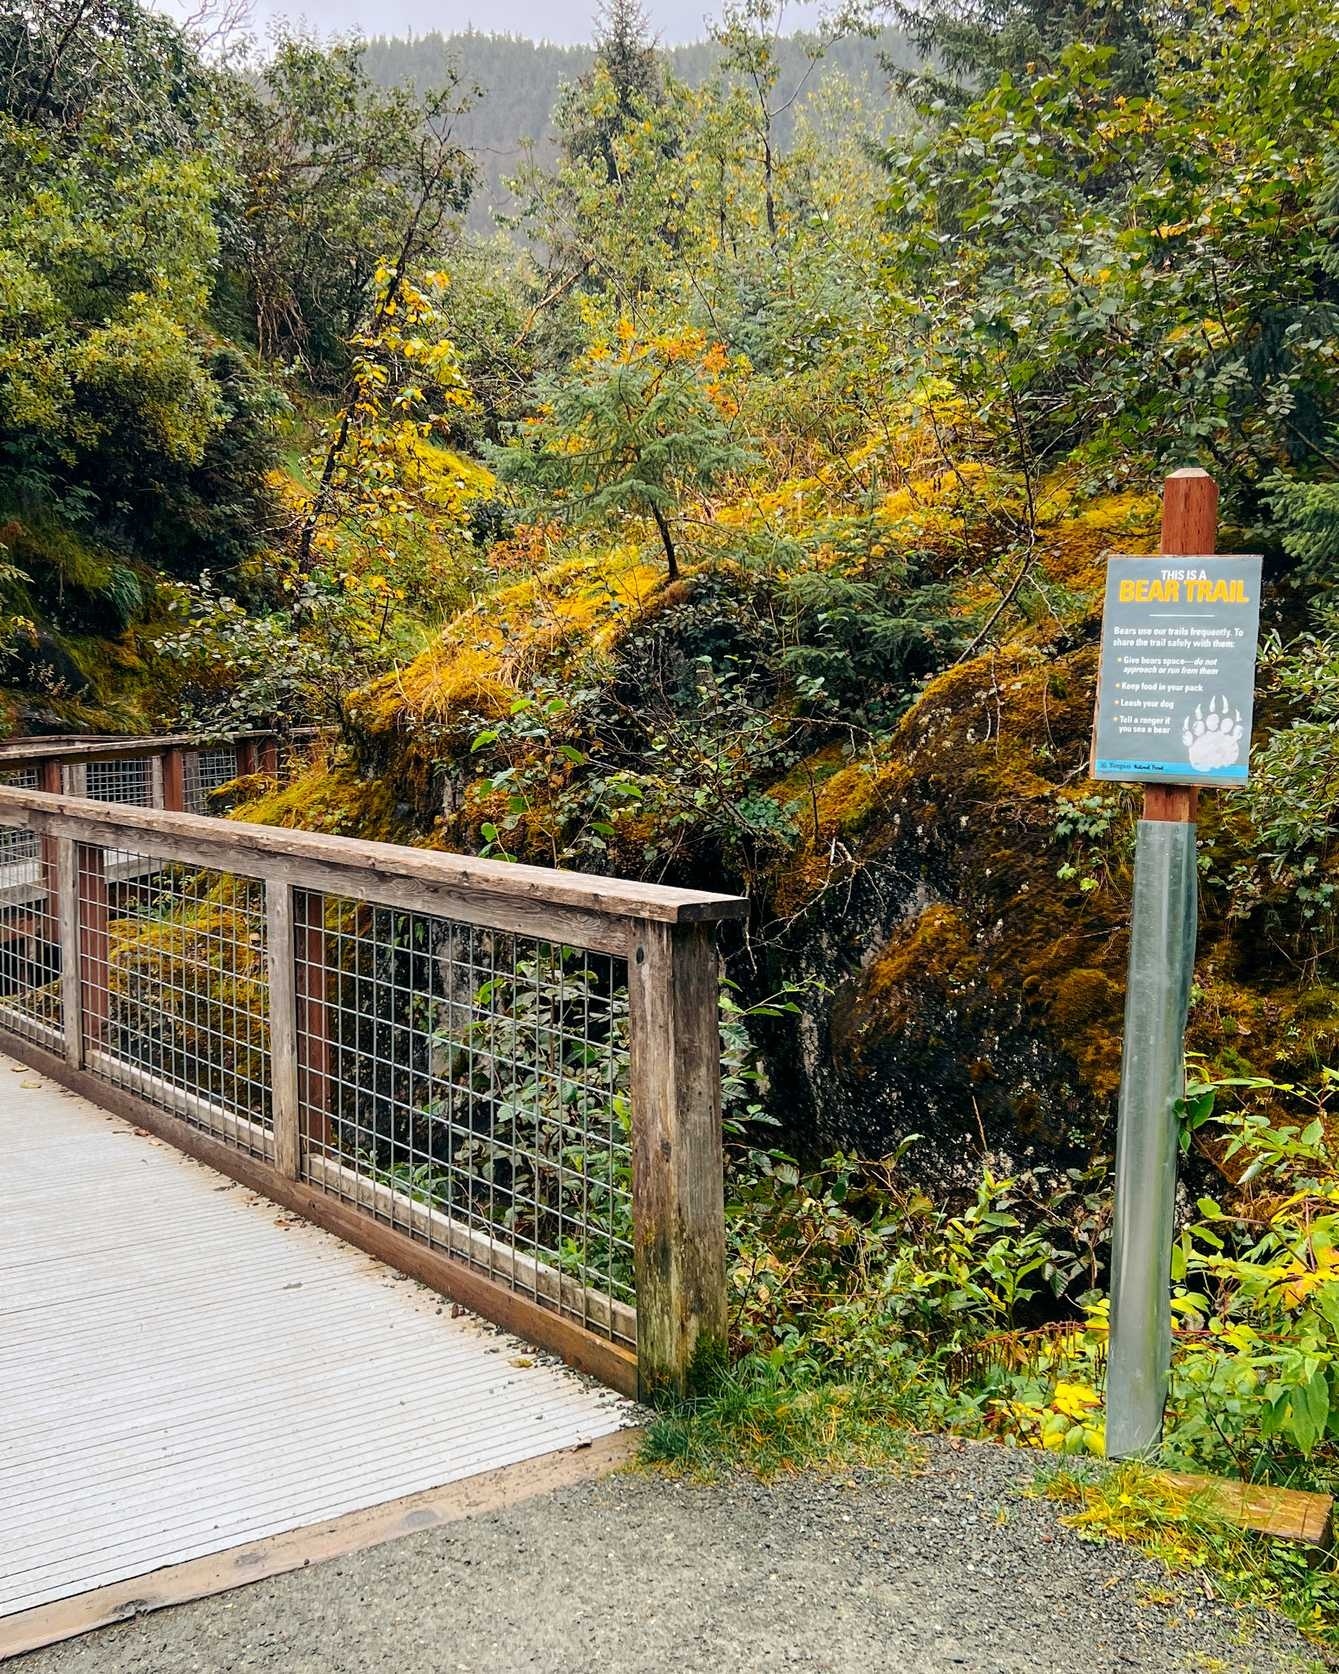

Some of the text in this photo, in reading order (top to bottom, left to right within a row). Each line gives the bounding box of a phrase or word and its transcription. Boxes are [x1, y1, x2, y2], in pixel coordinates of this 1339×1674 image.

[1161, 570, 1207, 580] THIS IS A
[1119, 580, 1249, 604] BEAR TRAIL
[1114, 627, 1136, 635] Bears
[1168, 628, 1188, 636] trails
[1191, 628, 1232, 638] frequently.
[1234, 628, 1244, 636] To
[1113, 638, 1135, 646] share
[1168, 639, 1191, 648] safely
[1123, 656, 1140, 664] Give
[1141, 657, 1161, 665] bears
[1123, 666, 1157, 674] approach
[1122, 682, 1140, 691] Keep
[1185, 684, 1203, 693] pack
[1120, 699, 1142, 707] Leash
[1160, 700, 1175, 709] dog
